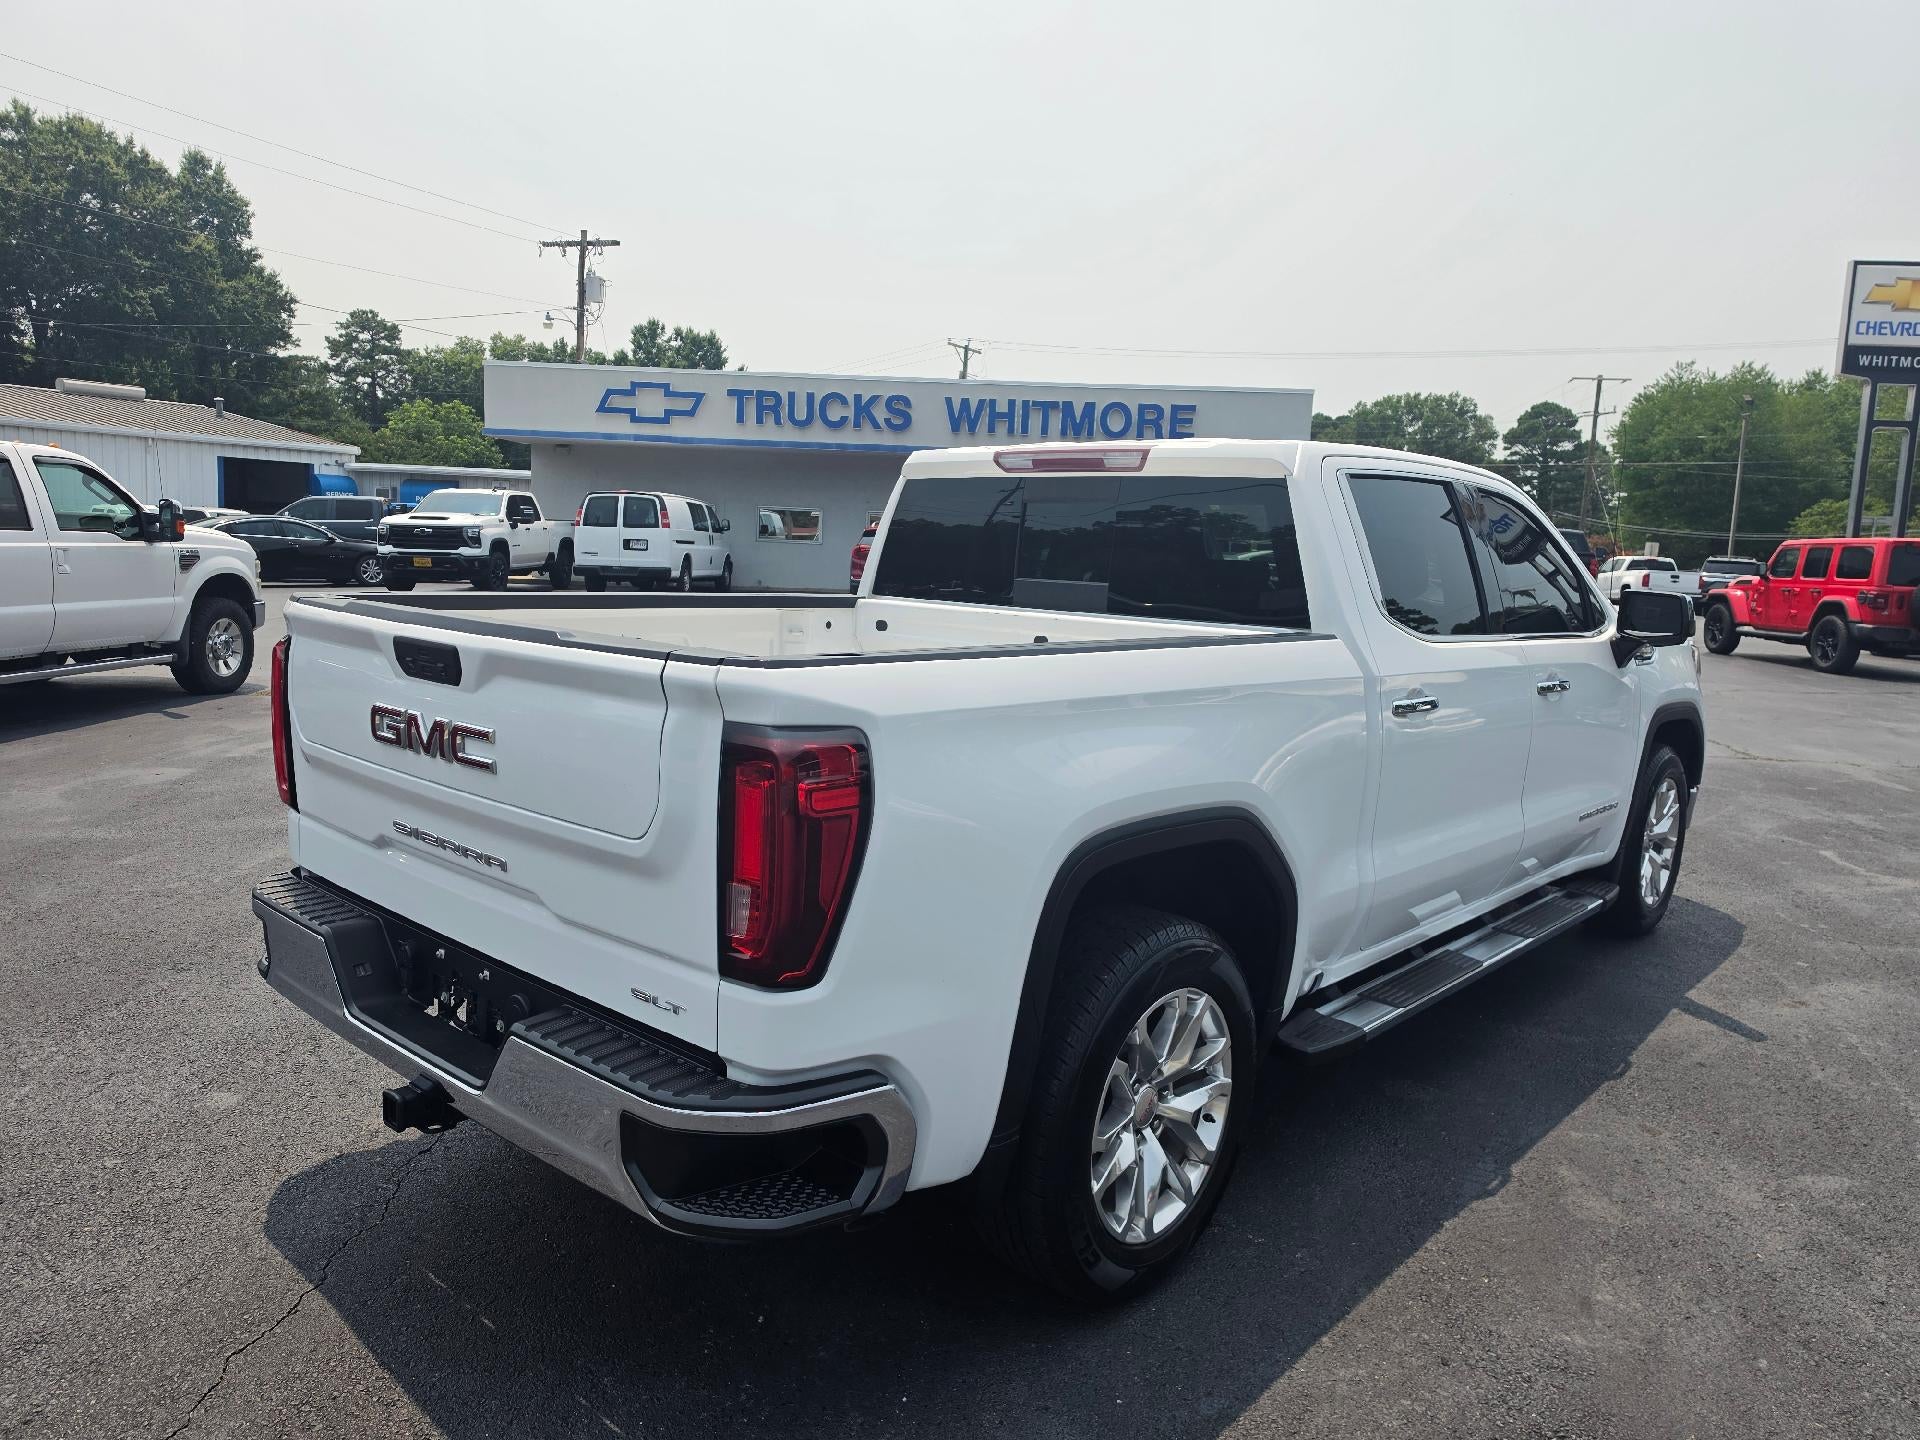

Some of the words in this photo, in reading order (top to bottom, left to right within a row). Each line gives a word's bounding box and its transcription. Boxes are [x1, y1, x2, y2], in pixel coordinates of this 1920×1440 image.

[726, 388, 913, 432] TRUCKS
[944, 396, 1197, 440] WHITMORE
[370, 701, 498, 775] GMC
[392, 819, 508, 873] SIERRA
[630, 987, 688, 1016] SLT
